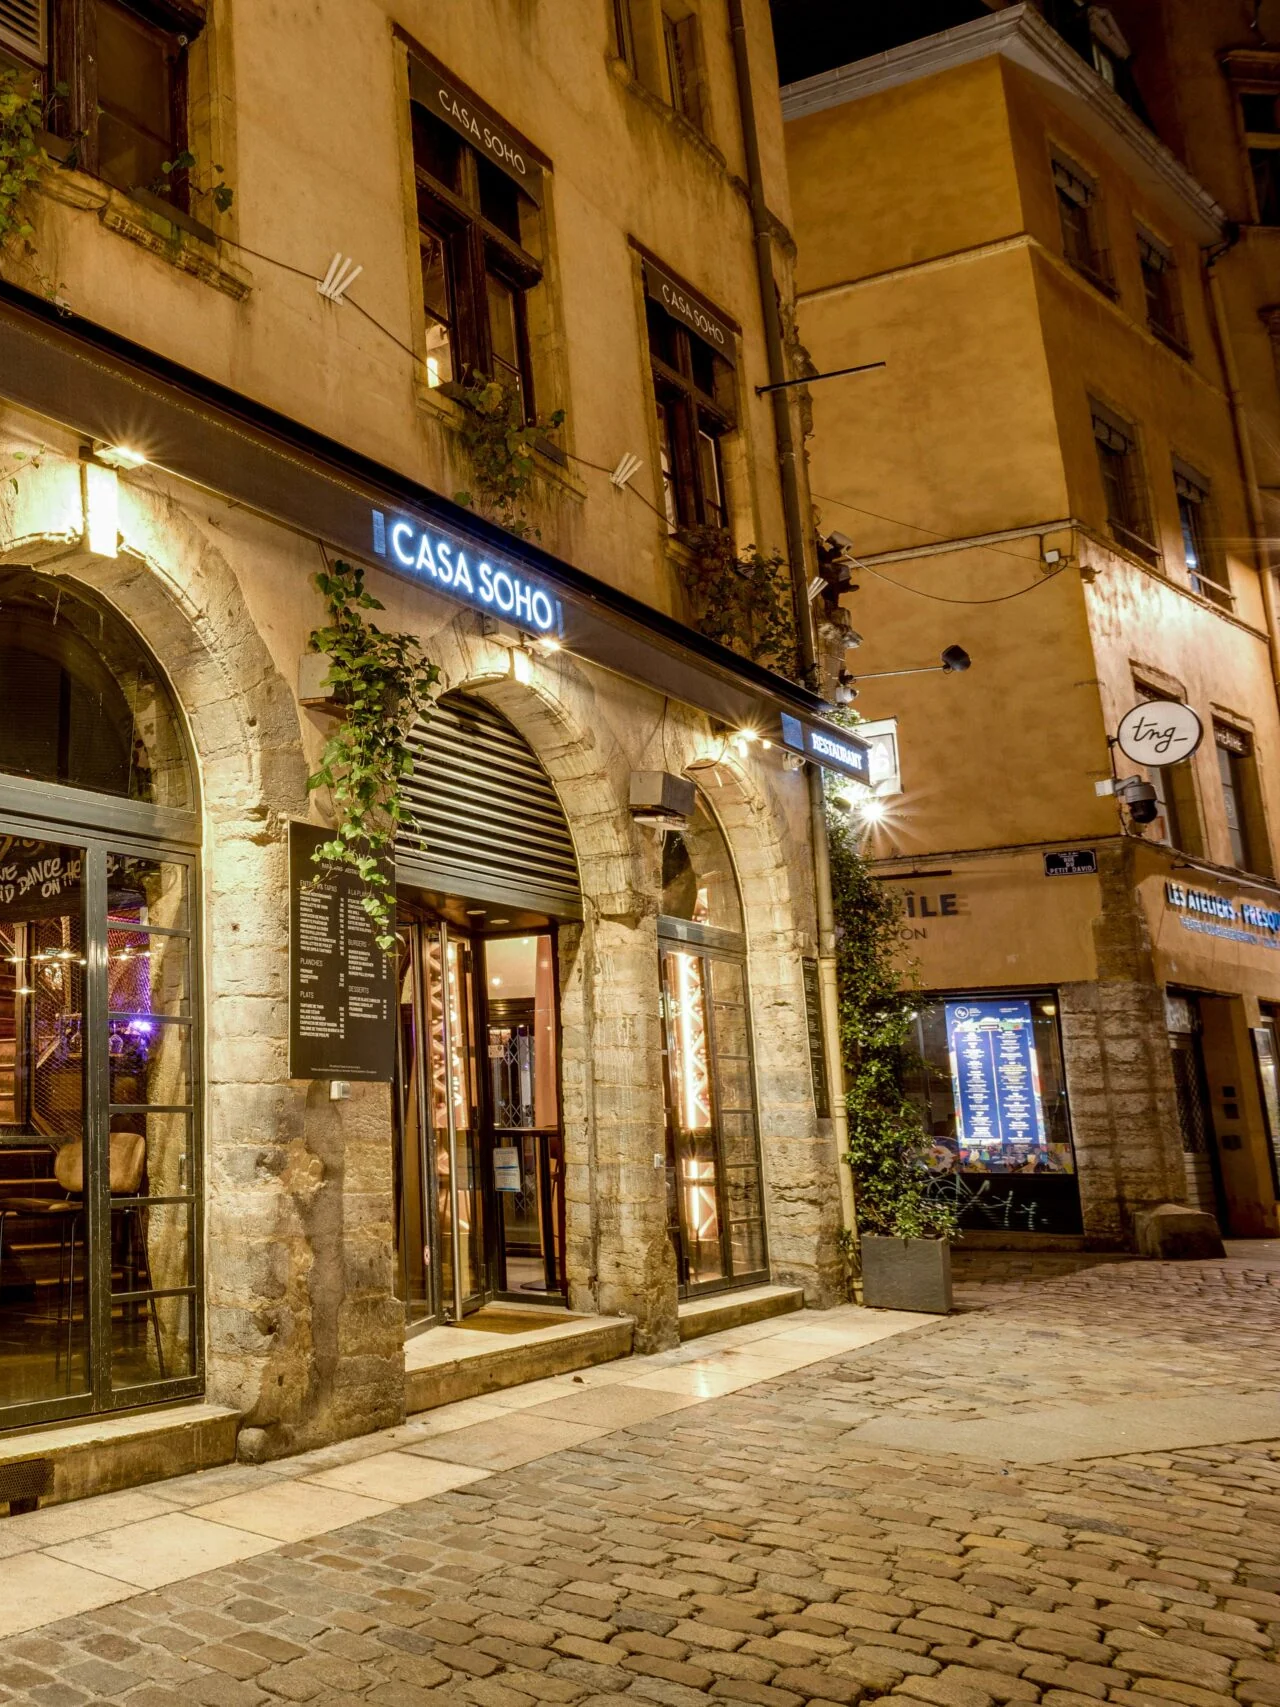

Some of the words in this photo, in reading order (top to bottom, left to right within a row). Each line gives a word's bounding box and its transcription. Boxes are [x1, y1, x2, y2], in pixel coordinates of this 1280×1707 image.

[438, 89, 481, 140] CASA
[483, 127, 526, 174] SOHO
[662, 284, 694, 321] CASA
[693, 310, 724, 344] SOHO
[392, 523, 475, 594] CASA
[478, 562, 553, 630] SOHO
[811, 732, 863, 770] RESTAURANT
[17, 857, 63, 896] DANCE
[41, 878, 61, 898] ON
[1071, 865, 1093, 873] DAVID
[1165, 881, 1187, 907] LES
[1187, 888, 1235, 920] ATELIERS
[299, 957, 324, 967] PLANCHES
[299, 990, 315, 999] PLATS
[348, 985, 370, 994] DESSERTS
